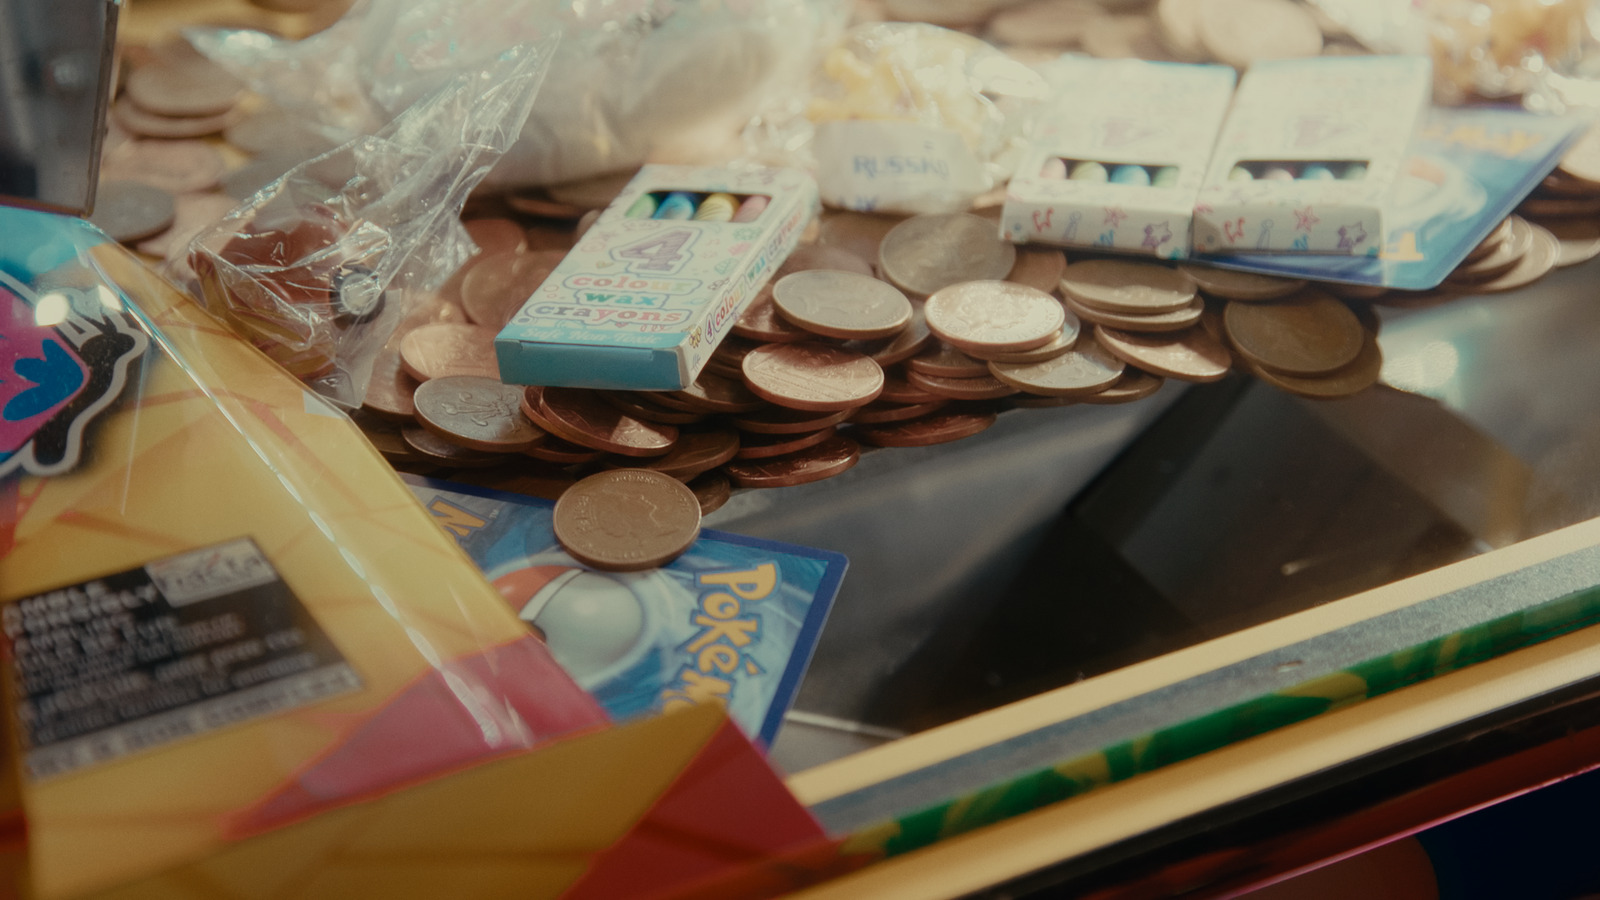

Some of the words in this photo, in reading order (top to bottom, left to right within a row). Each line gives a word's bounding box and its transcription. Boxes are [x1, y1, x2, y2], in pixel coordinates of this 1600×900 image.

[619, 230, 694, 272] 4
[572, 274, 694, 292] colour
[584, 292, 660, 307] wax
[534, 305, 684, 322] crayons
